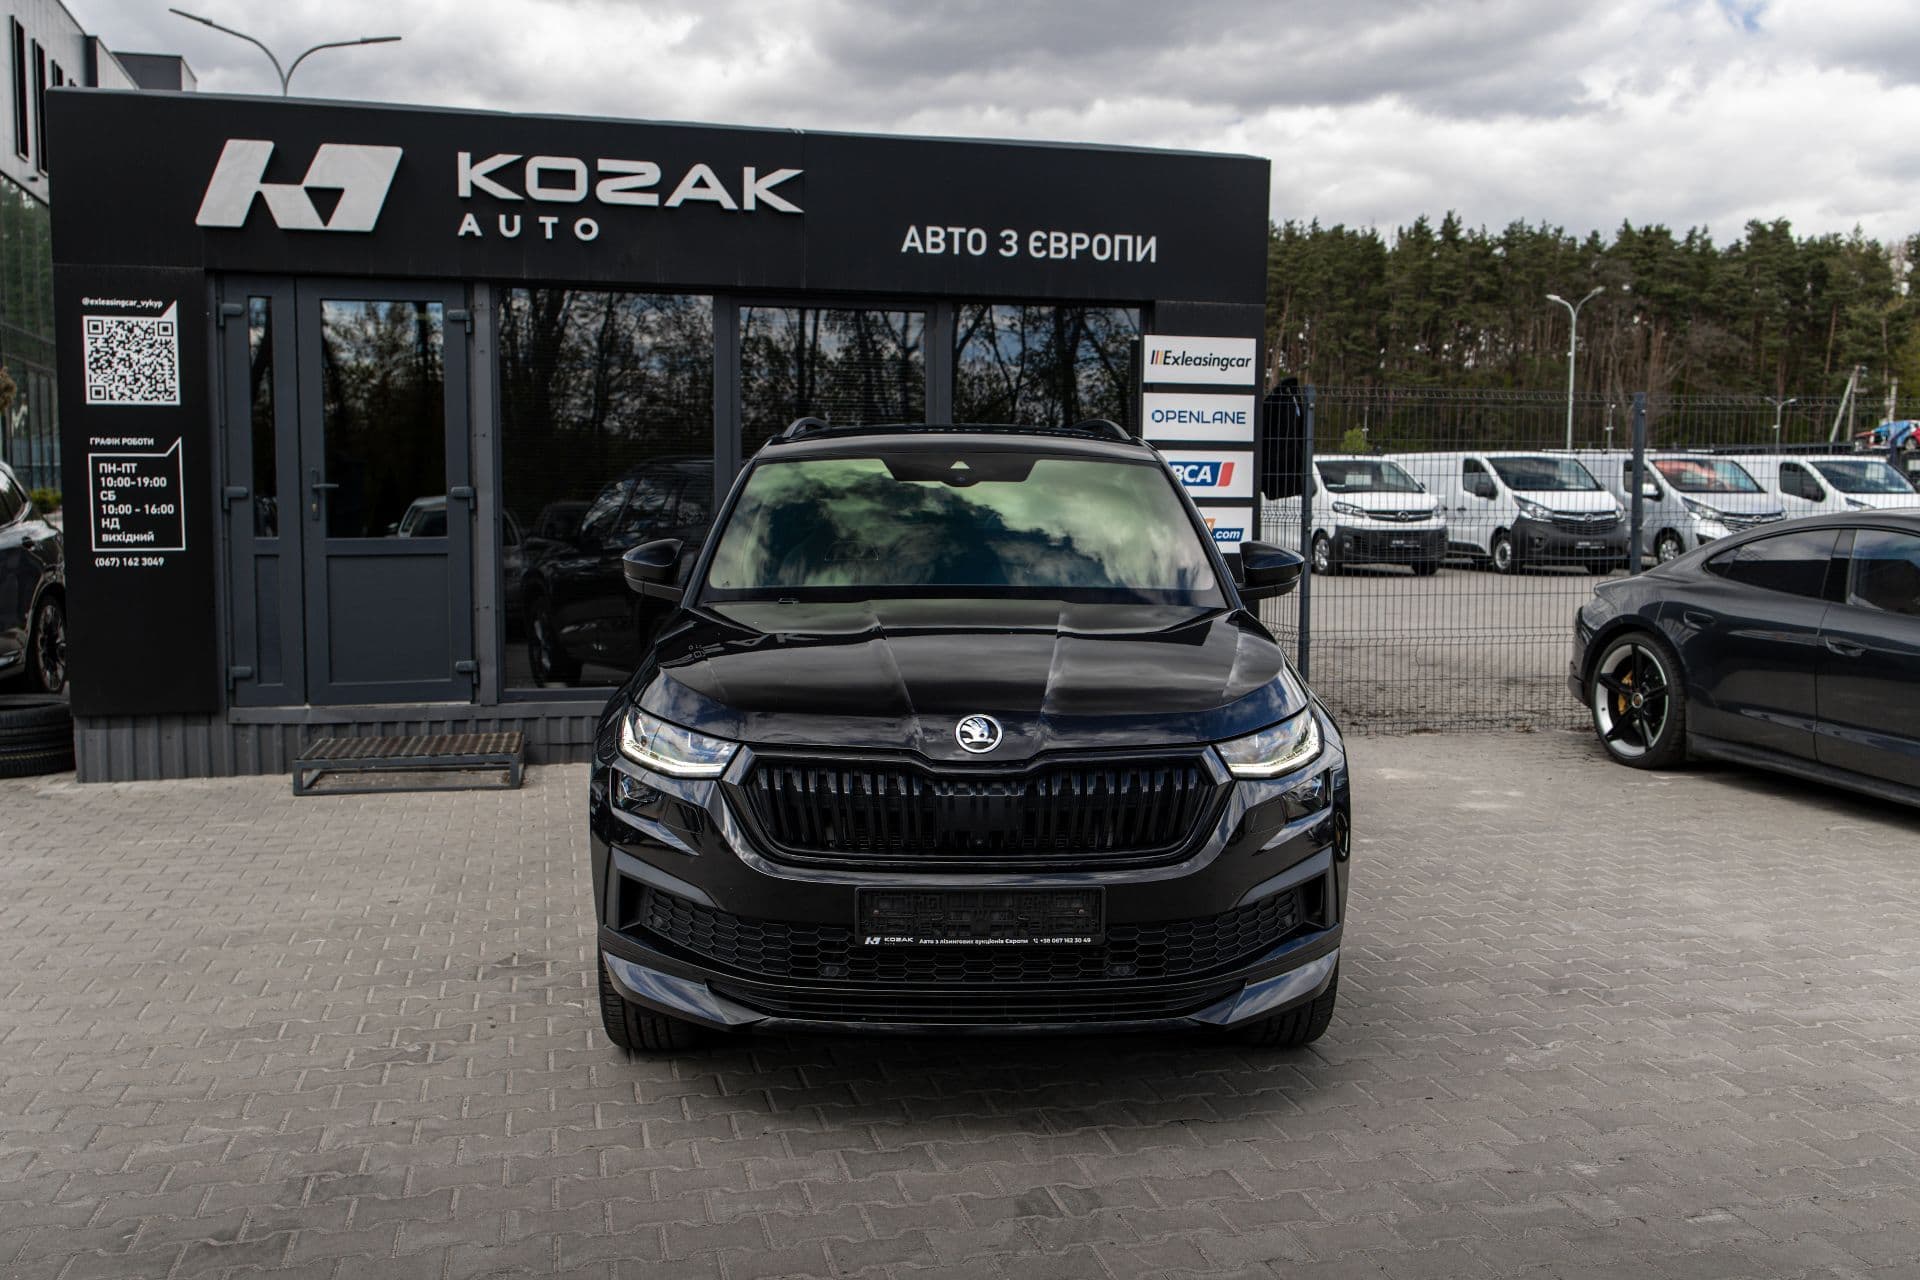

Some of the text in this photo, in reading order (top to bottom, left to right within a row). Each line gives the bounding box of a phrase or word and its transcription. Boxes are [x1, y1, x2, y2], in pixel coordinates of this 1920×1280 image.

[458, 152, 804, 213] KOZAK
[457, 212, 599, 241] AUTO
[901, 225, 1157, 263] АВТО З ЄВРОПИ
[1163, 349, 1252, 372] Exleasingcar
[1151, 409, 1246, 425] OPENLANE
[89, 437, 154, 446] ГРАФІК РОБОТИ
[99, 463, 138, 474] ПН-ПТ
[1172, 465, 1212, 483] BCA
[100, 477, 167, 488] 10:00-19:00
[100, 490, 116, 501] СБ
[101, 504, 132, 515] 10:00
[144, 504, 175, 515] 16:00
[101, 518, 120, 530] НД
[102, 531, 155, 544] вихідний
[95, 557, 165, 568] (067) 162 3049
